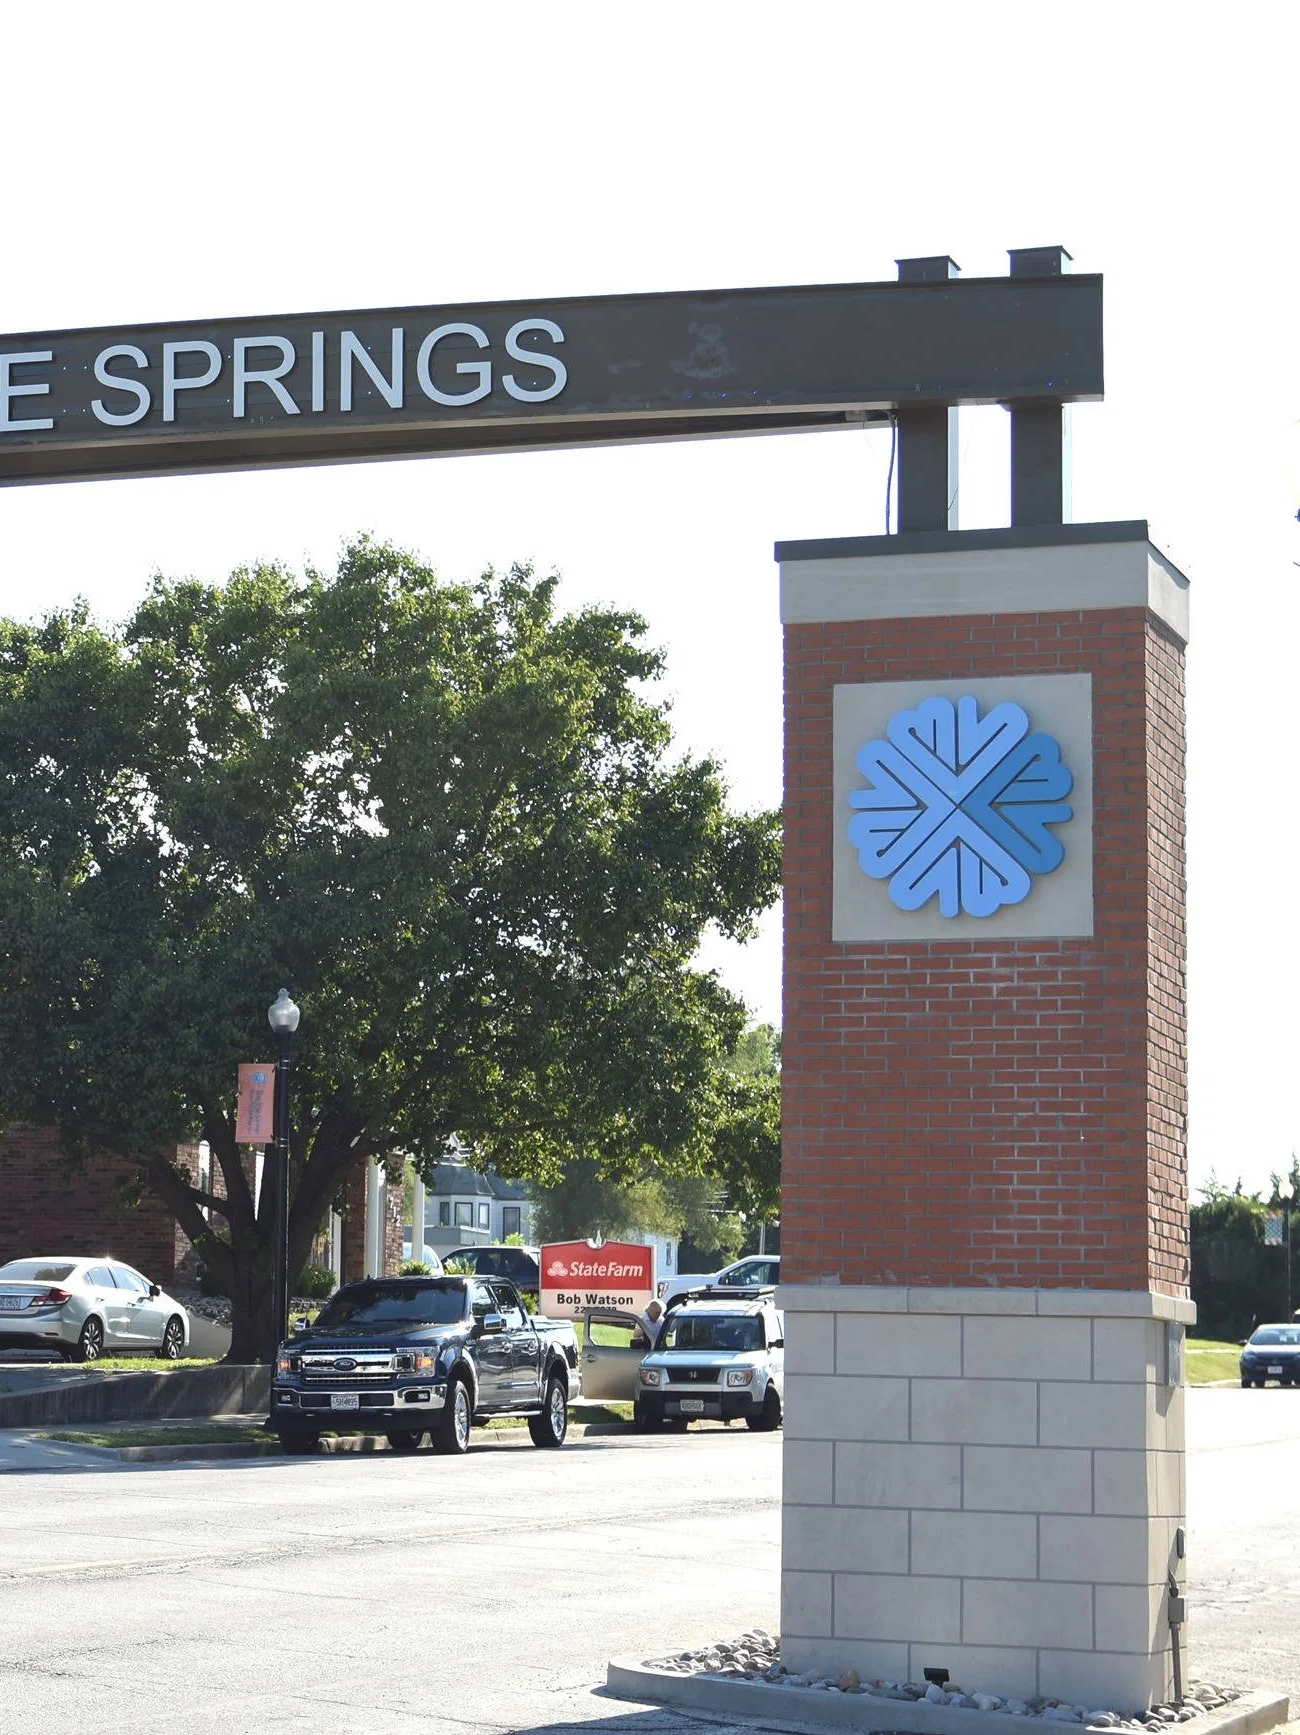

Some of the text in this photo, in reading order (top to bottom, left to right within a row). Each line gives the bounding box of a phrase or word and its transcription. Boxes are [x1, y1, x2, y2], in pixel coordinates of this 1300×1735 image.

[91, 318, 568, 428] SPRINGS
[557, 1294, 634, 1305] Bob Watson
